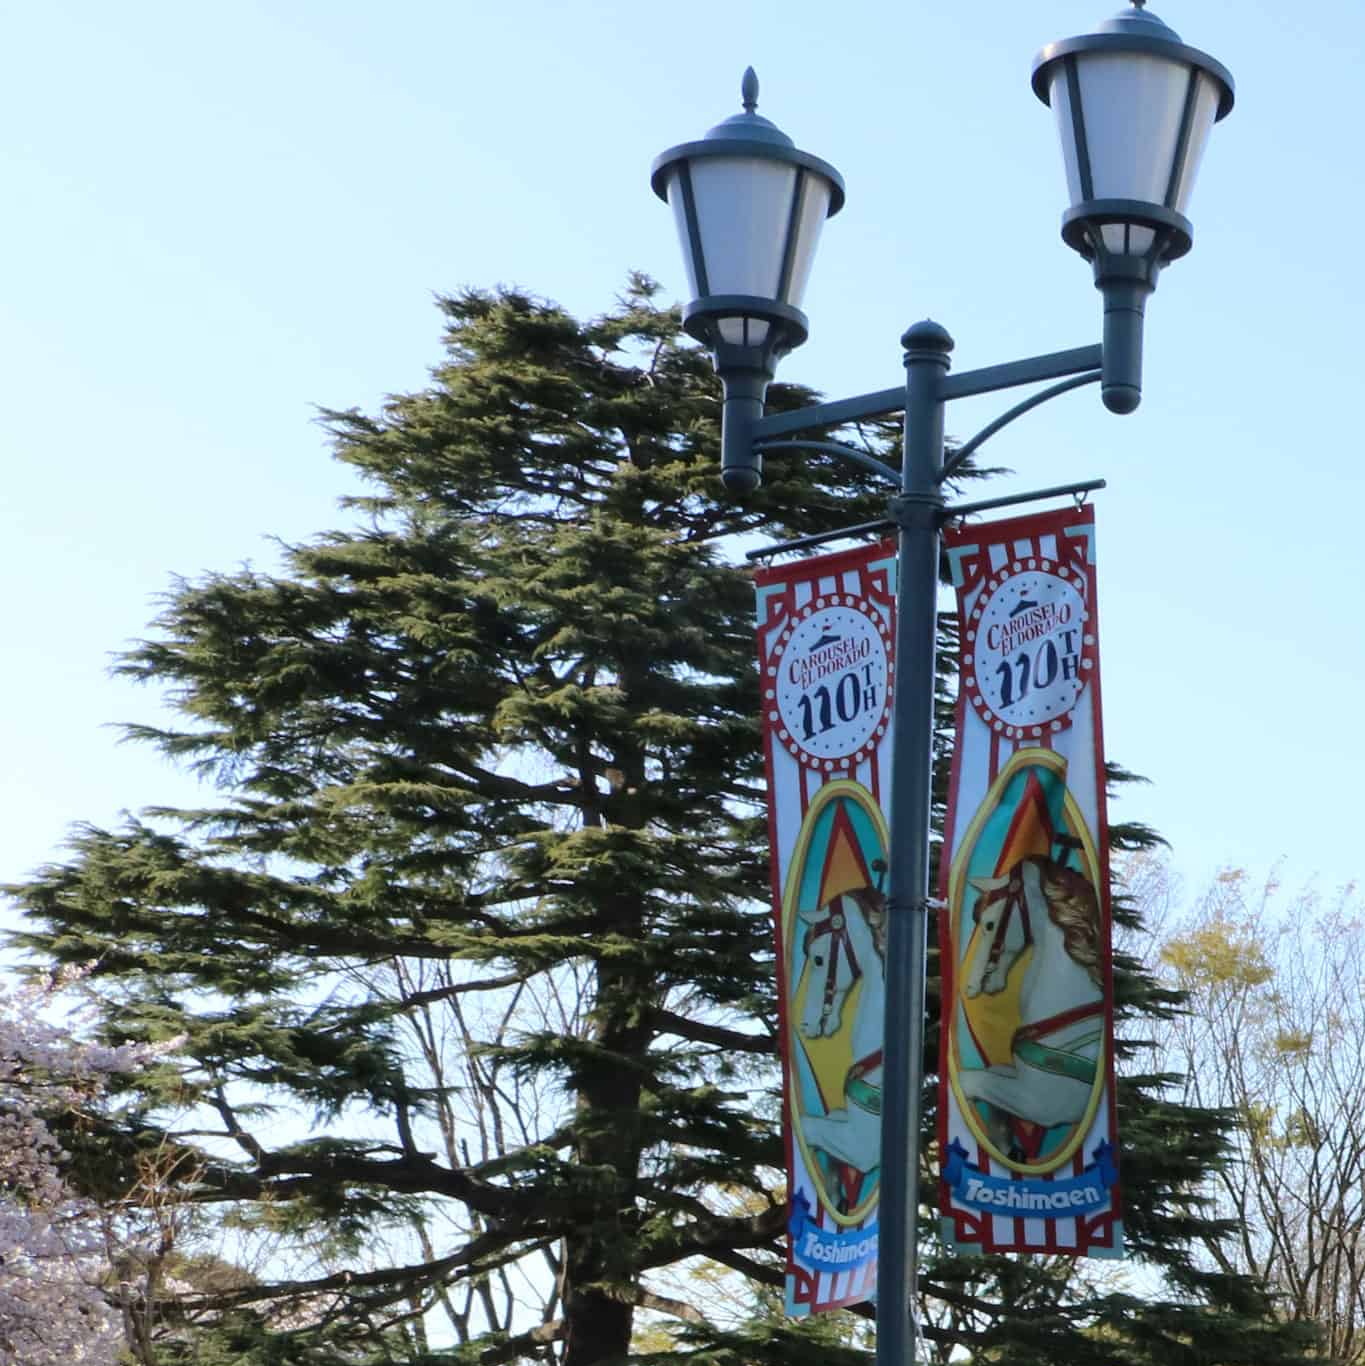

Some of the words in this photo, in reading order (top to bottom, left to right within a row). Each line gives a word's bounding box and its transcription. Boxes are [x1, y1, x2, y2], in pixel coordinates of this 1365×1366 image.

[987, 602, 1056, 650] CAROUSEL
[790, 637, 857, 685] CAROUSEL
[817, 637, 870, 678] DORADO
[996, 639, 1058, 709] 110
[798, 673, 860, 742] 110
[966, 1178, 1100, 1210] Toshimaen
